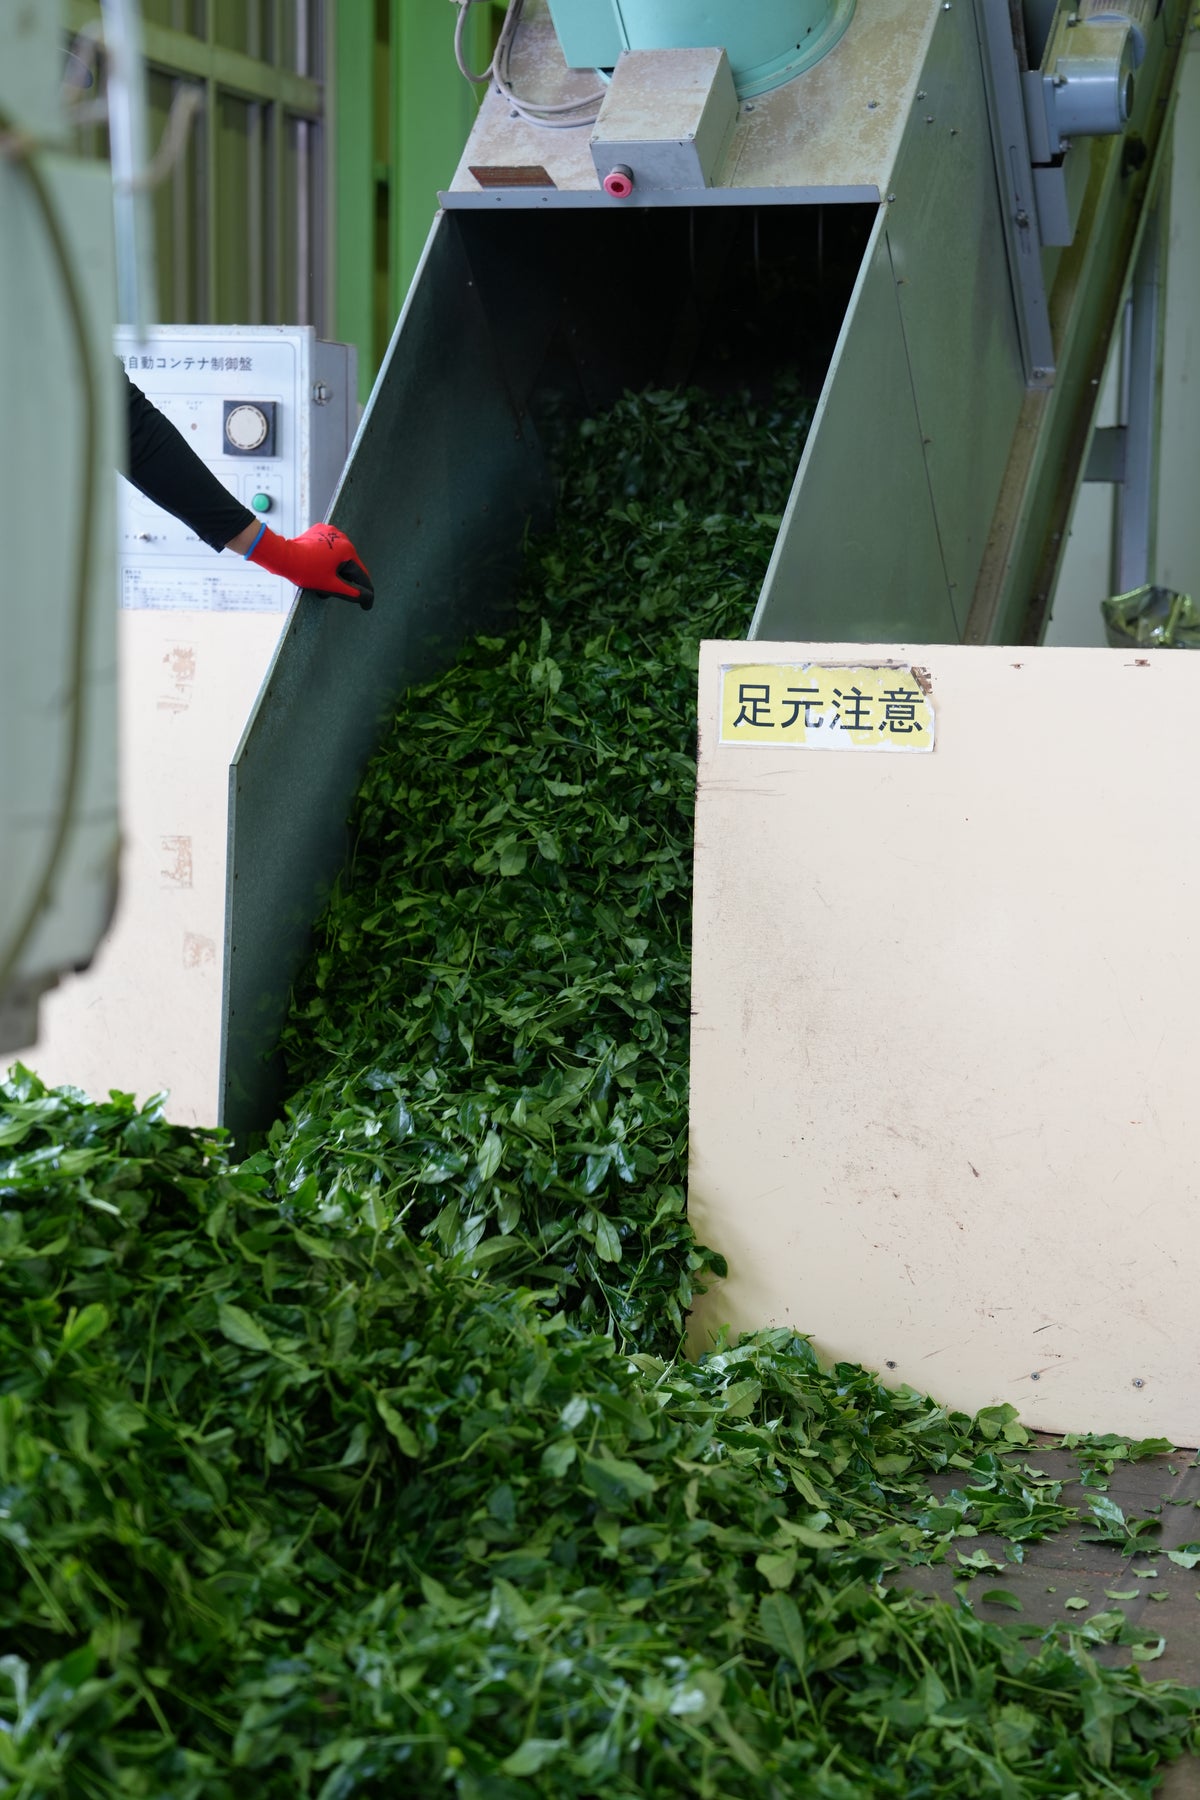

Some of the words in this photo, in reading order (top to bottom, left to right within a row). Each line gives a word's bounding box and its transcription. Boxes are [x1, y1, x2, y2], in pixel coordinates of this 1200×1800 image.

[121, 355, 253, 371] 自動コンテナ制御盤
[733, 683, 925, 733] 足元注意
